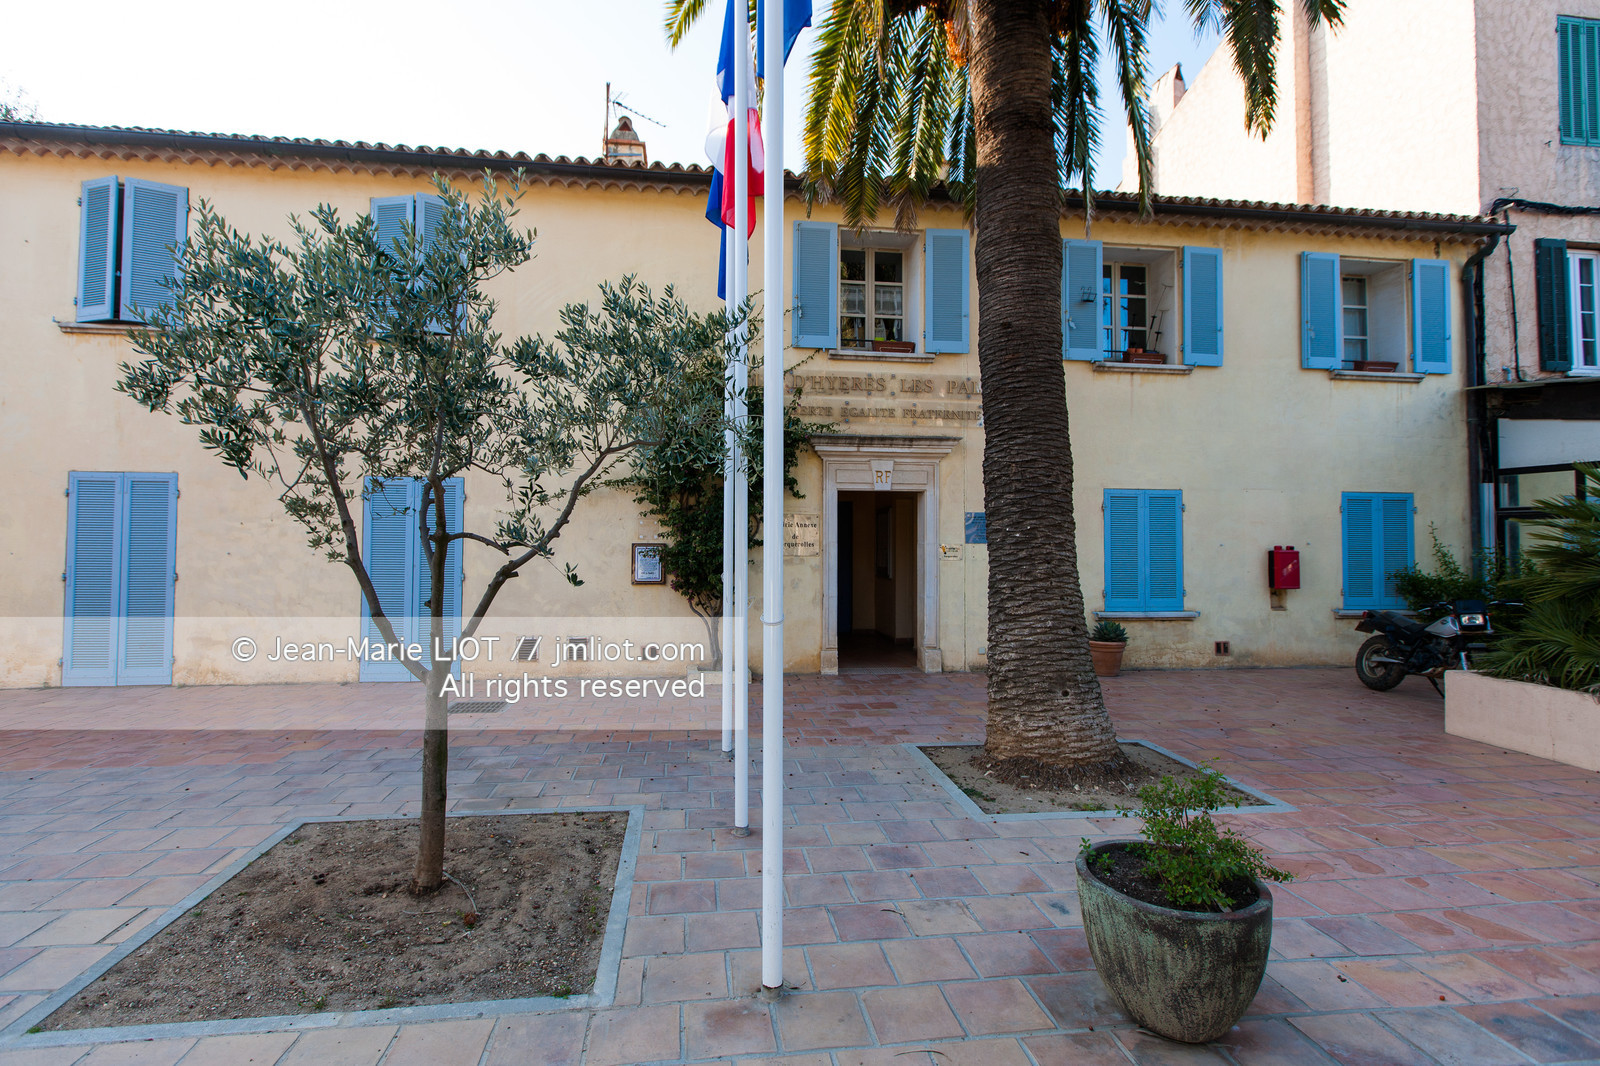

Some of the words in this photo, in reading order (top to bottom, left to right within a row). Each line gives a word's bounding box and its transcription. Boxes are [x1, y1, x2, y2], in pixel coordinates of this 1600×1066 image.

[900, 379, 935, 394] LES
[947, 380, 982, 395] PAL
[875, 470, 892, 484] RF
